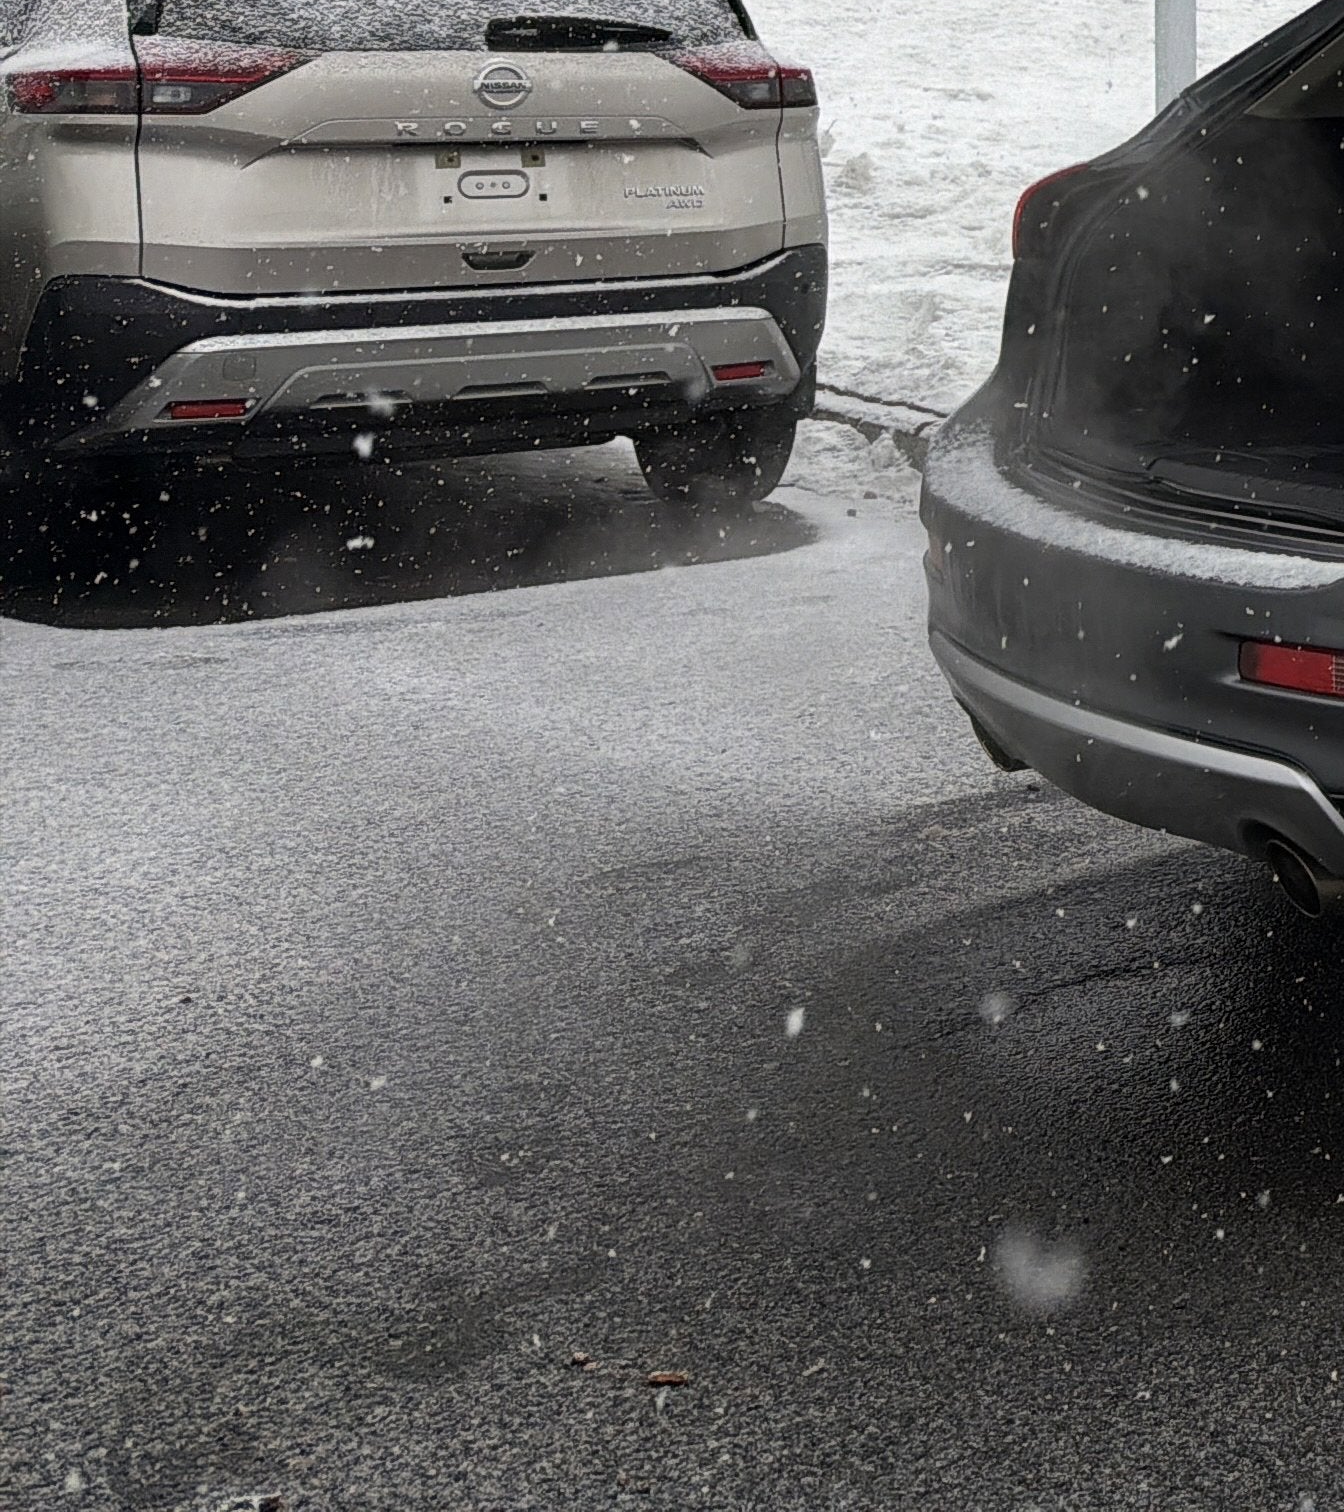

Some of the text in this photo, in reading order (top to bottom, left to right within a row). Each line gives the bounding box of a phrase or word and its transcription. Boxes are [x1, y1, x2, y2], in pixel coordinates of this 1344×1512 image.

[479, 80, 529, 90] NISSAN
[395, 119, 600, 137] ROGUE
[623, 185, 705, 199] PLATINUM
[665, 199, 704, 209] AWD
